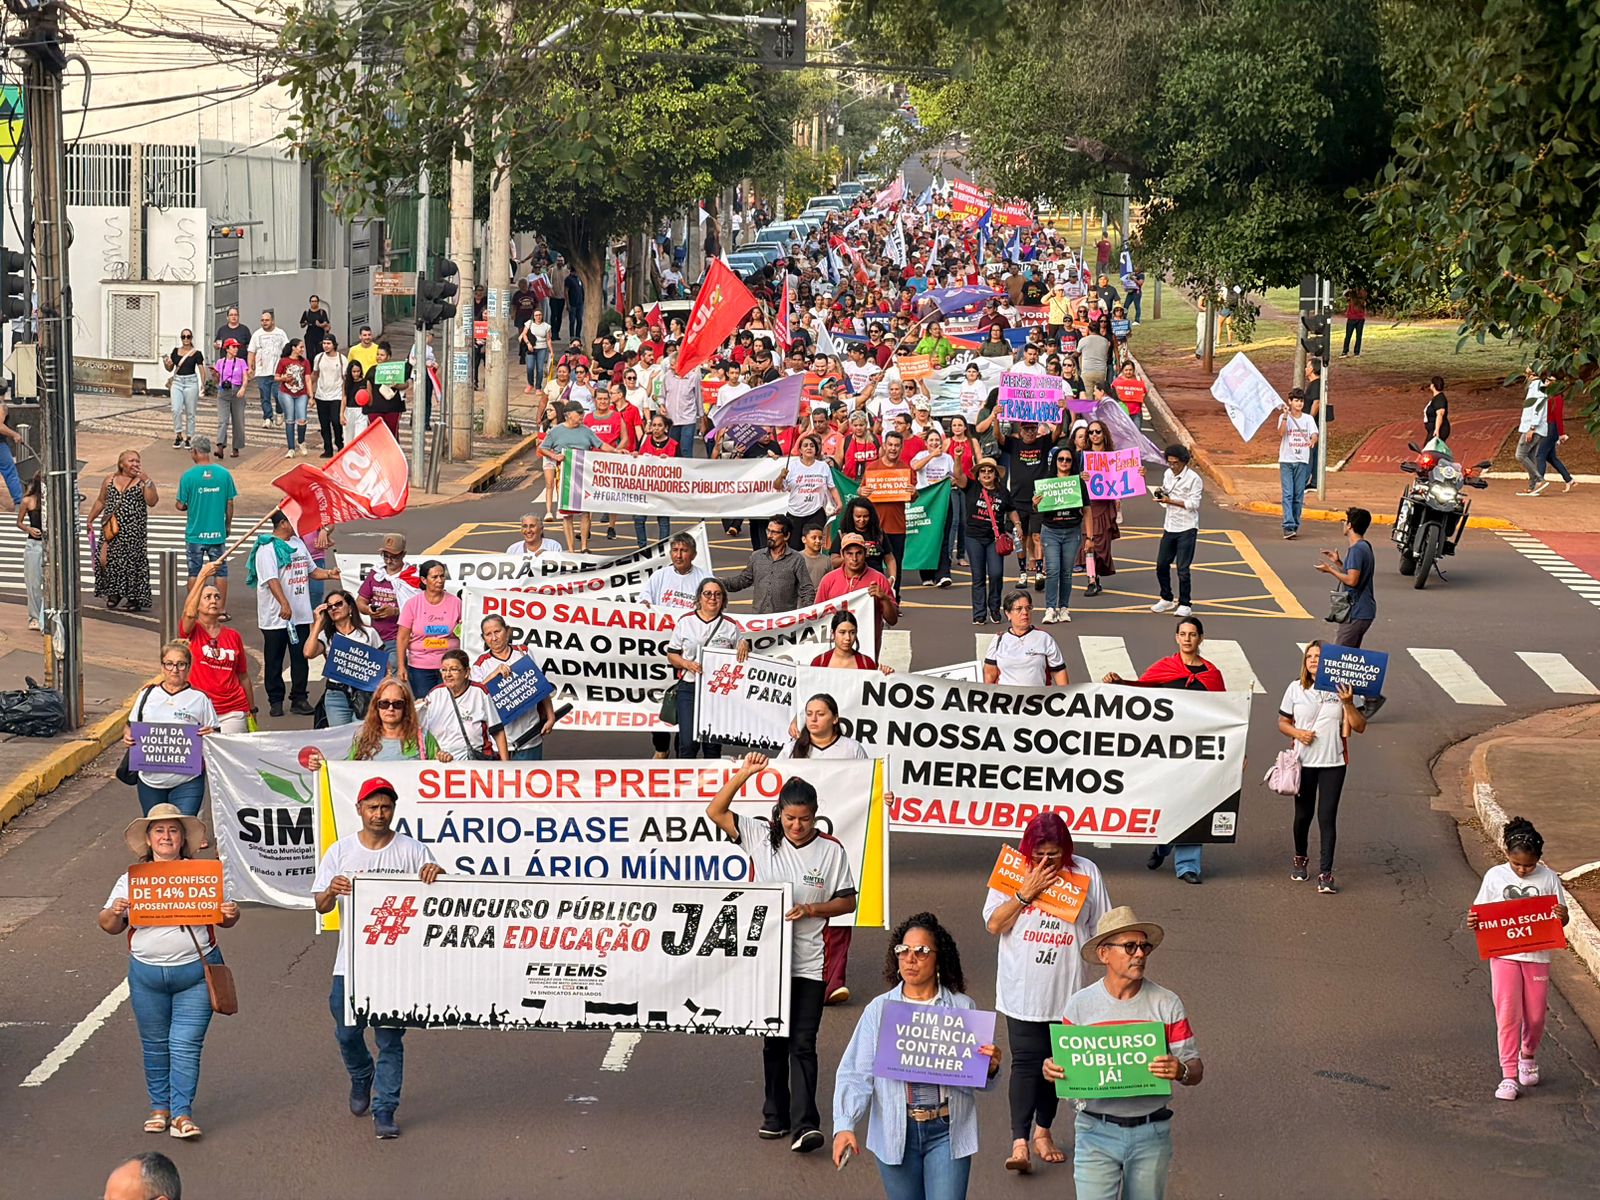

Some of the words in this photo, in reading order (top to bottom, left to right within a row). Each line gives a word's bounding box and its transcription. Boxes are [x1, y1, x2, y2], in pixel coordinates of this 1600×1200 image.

[1000, 400, 1060, 422] TRABALHADOR
[592, 460, 628, 476] CONTRA
[630, 464, 637, 476] O
[638, 464, 682, 479] ARROCHO
[592, 475, 610, 488] AOS
[612, 477, 690, 494] TRABALHADORES
[692, 478, 736, 494] PÚBLICOS
[458, 556, 534, 580] PORÃ
[610, 570, 641, 588] DE
[482, 595, 547, 621] PISO
[552, 603, 676, 632] SALARIA
[508, 626, 585, 652] PARA
[590, 634, 612, 654] O
[349, 646, 364, 656] NÃO
[1341, 654, 1358, 662] NÃO
[333, 656, 346, 666] DOS
[347, 660, 378, 677] SERVIÇOS
[1324, 666, 1340, 676] DOS
[1342, 669, 1376, 682] SERVIÇOS
[497, 675, 513, 689] NÃO
[495, 697, 510, 710] DOS
[510, 676, 538, 700] SERVIÇOS
[746, 684, 792, 706] PARA
[861, 680, 936, 711] NOS
[941, 686, 1174, 722] ARRISCAMOS
[140, 736, 192, 746] VIOLÊNCIA
[150, 728, 168, 736] FIM
[170, 728, 184, 736] DA
[840, 718, 877, 745] OR
[887, 720, 1006, 752] NOSSA
[1012, 727, 1226, 761] SOCIEDADE!
[142, 745, 181, 754] CONTRA
[146, 754, 186, 764] MULHER
[418, 769, 584, 800] SENHOR
[902, 760, 1124, 794] MERECEMOS
[395, 810, 630, 843] ALÁRIO-BASE
[248, 844, 278, 854] Sindicato
[259, 852, 292, 860] Trabalhadores
[250, 866, 276, 876] Filiado
[621, 848, 748, 882] MÍNIMO
[1002, 854, 1022, 870] DE
[131, 877, 148, 886] FIM
[151, 876, 166, 885] DO
[168, 876, 218, 884] CONFISCO
[133, 888, 152, 900] DE
[156, 887, 184, 899] 14%
[188, 886, 216, 898] DAS
[133, 902, 196, 910] APOSENTADAS
[198, 902, 218, 910] (OS)!
[422, 896, 551, 920] CONCURSO
[556, 896, 658, 922] PÚBLICO
[660, 891, 768, 958] JÁ!
[1040, 920, 1060, 930] PARA
[1478, 920, 1498, 930] FIM
[1500, 917, 1516, 928] DA
[1519, 911, 1558, 924] ESCALA
[422, 924, 496, 949] PARA
[502, 922, 652, 958] EDUCAÇÃO
[1023, 930, 1074, 948] EDUCAÇÃO
[1506, 925, 1533, 939] 6X1
[1035, 948, 1058, 965] JÁ!
[526, 962, 608, 978] FETEMS
[912, 1011, 939, 1026] FIM
[944, 1015, 964, 1028] DA
[896, 1023, 976, 1046] VIOLÊNCIA
[1058, 1034, 1157, 1050] CONCURSO
[896, 1038, 958, 1058] CONTRA
[962, 1047, 972, 1058] A
[900, 1054, 964, 1072] MULHER
[1071, 1050, 1147, 1066] PÚBLICO
[1098, 1066, 1122, 1086] JÁ!
